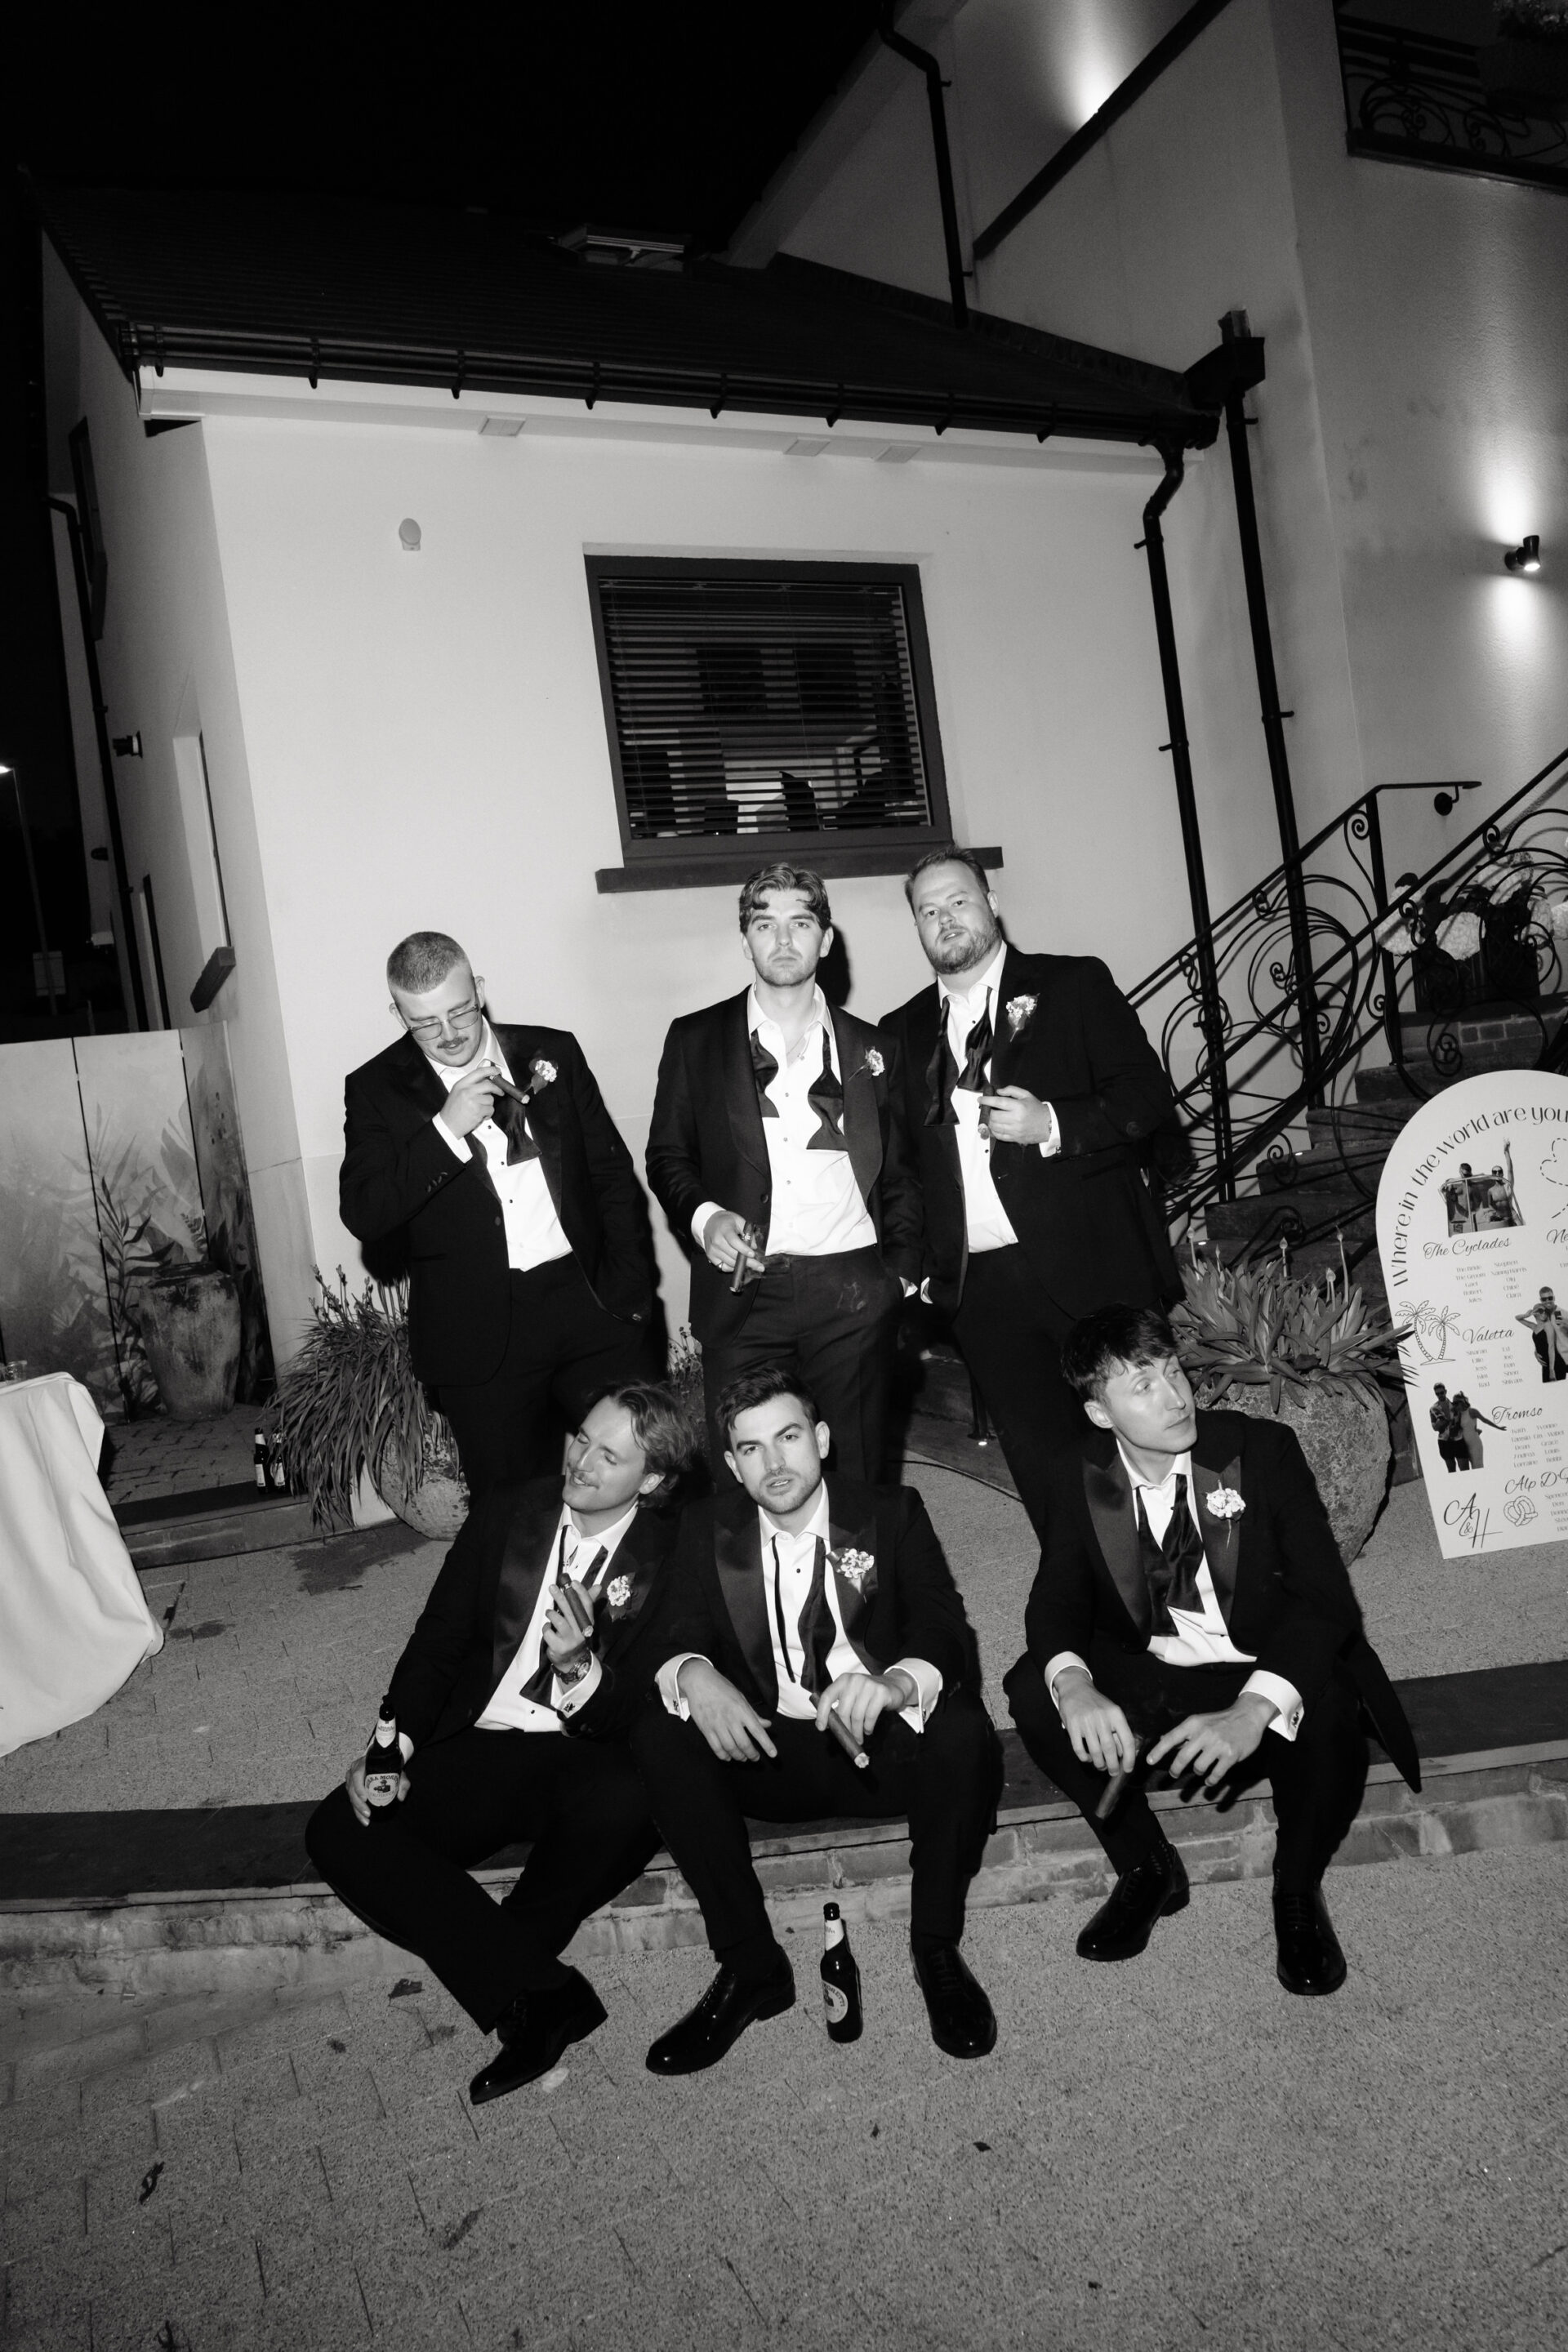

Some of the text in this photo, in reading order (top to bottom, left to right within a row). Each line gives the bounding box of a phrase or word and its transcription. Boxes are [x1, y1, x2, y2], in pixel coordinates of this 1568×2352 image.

[1391, 1107, 1568, 1287] Where in the world are you
[1423, 1237, 1511, 1259] The Cyclades
[1463, 1326, 1514, 1343] Valetta
[1492, 1405, 1543, 1424] Tromso
[1504, 1474, 1537, 1494] Alp
